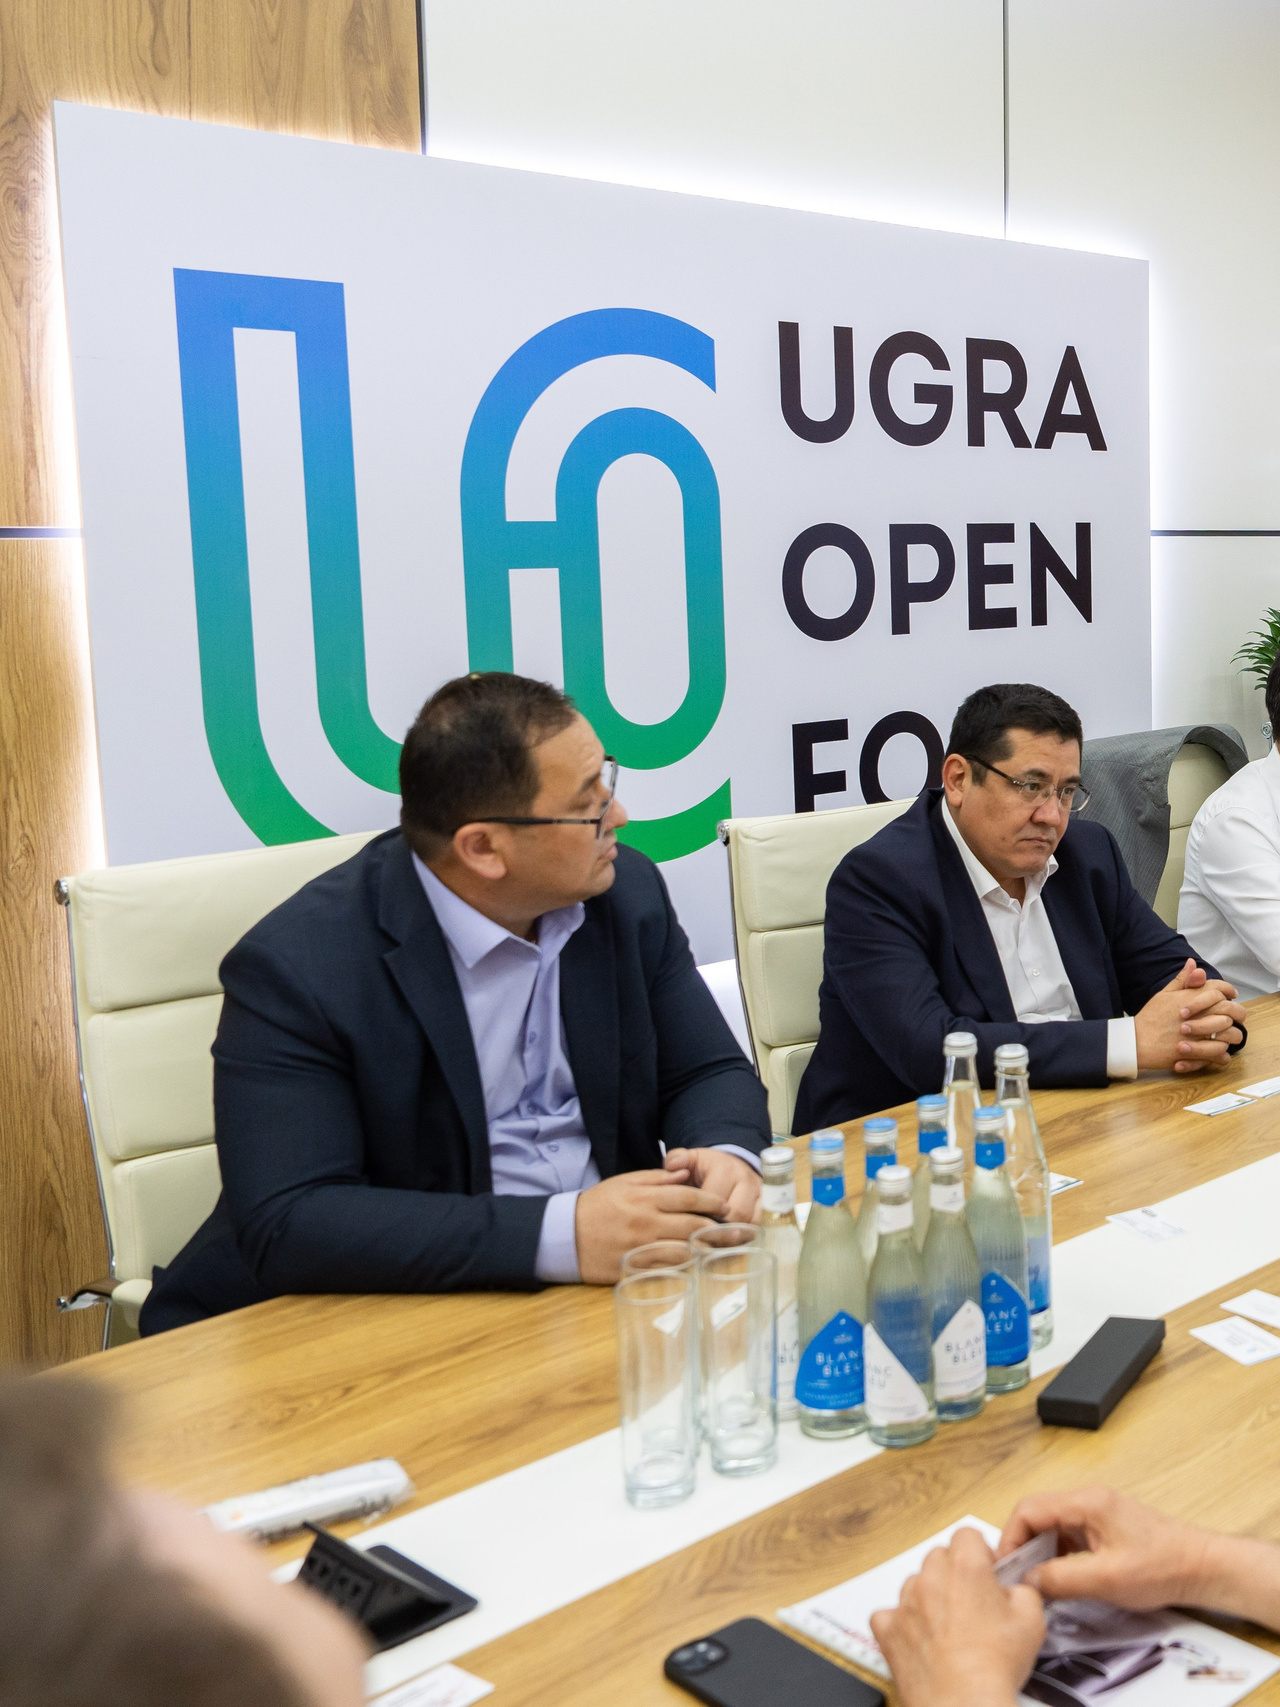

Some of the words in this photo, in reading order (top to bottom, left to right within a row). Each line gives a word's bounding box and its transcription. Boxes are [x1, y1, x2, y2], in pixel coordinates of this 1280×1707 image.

[778, 320, 1107, 451] UGRA
[782, 522, 1093, 642] OPEN
[792, 711, 945, 814] FO
[815, 1349, 863, 1366] BLAN
[944, 1333, 984, 1354] BLAN
